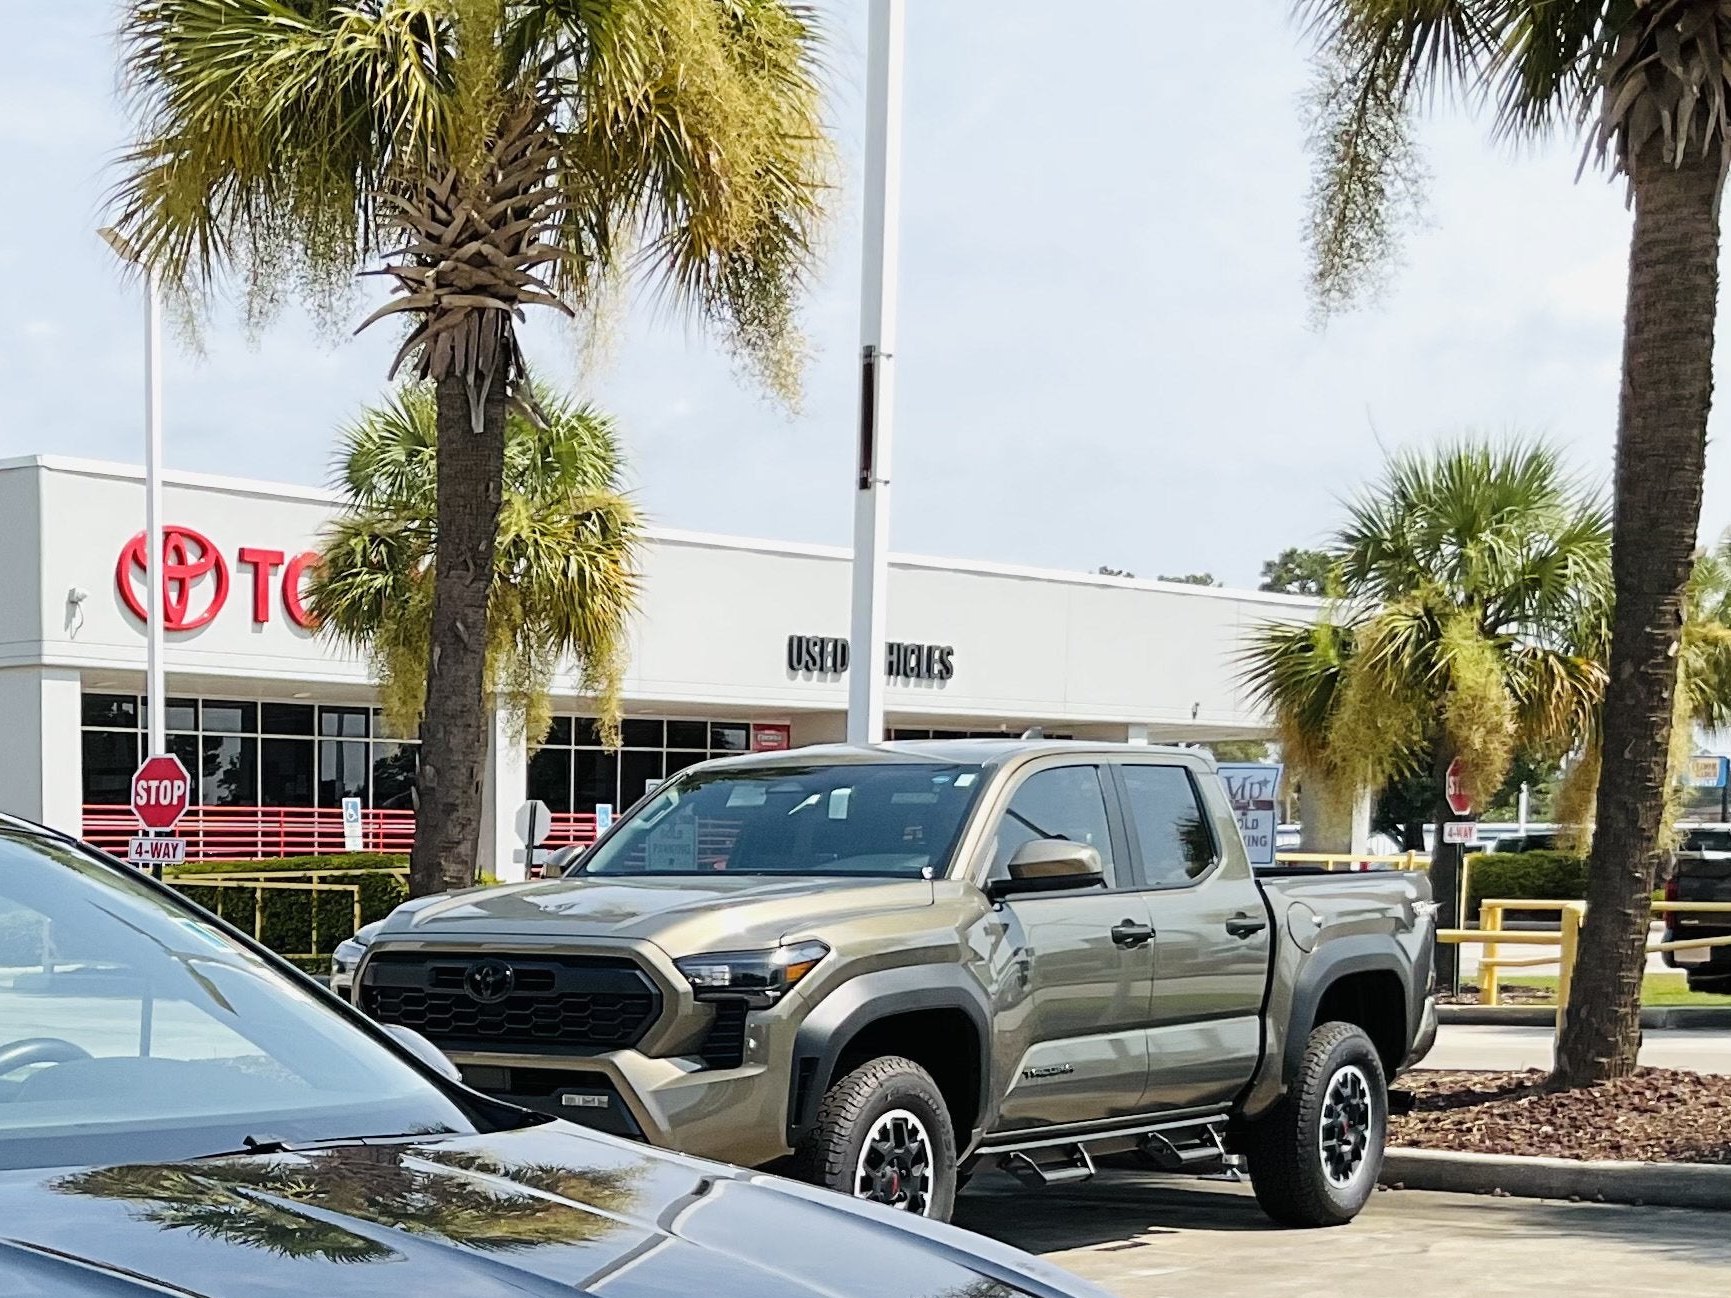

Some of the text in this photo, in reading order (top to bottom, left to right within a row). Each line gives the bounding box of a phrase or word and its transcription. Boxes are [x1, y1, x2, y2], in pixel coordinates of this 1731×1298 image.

[787, 634, 954, 681] USED HICLES
[135, 778, 184, 806] STOP
[1237, 818, 1259, 830] OLD
[1447, 826, 1473, 839] 4-WAY
[135, 841, 180, 859] 4-WAY
